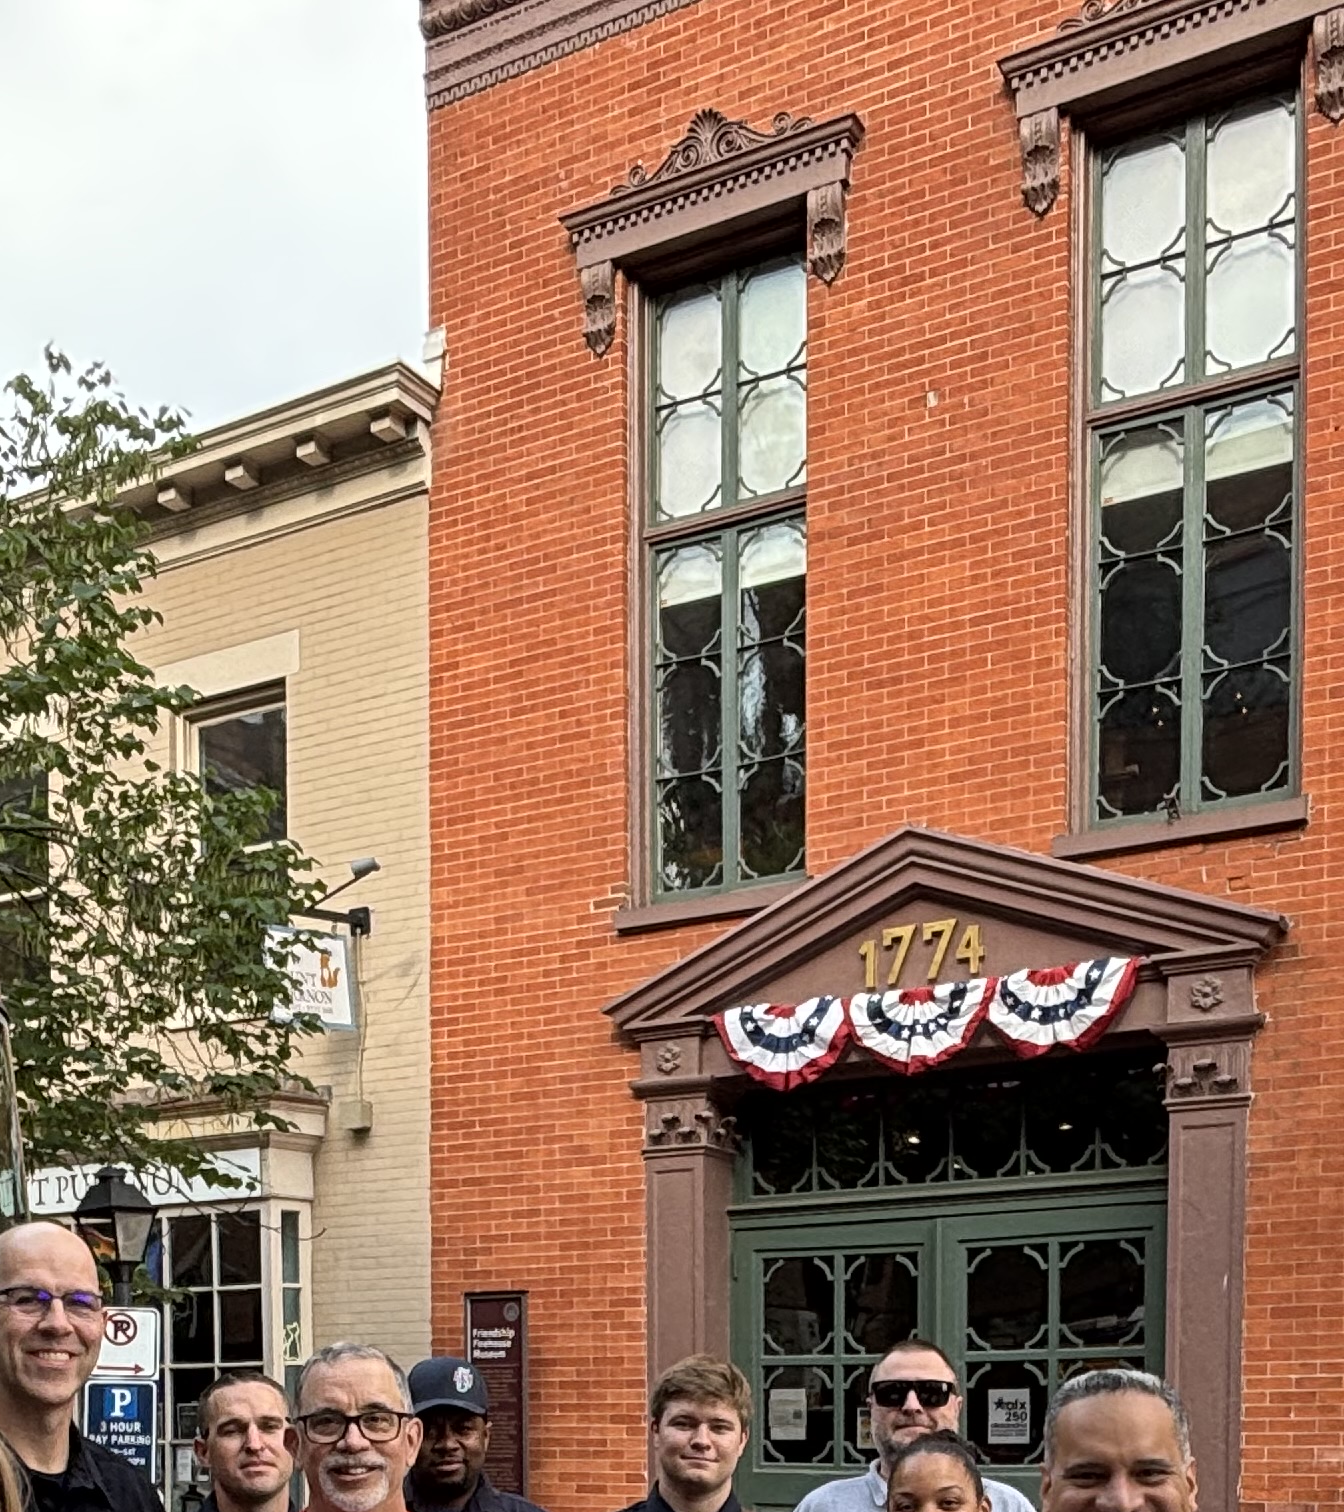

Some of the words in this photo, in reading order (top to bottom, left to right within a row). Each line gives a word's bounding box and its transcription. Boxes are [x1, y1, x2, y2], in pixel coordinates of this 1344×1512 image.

[858, 917, 986, 989] 1774
[1004, 1411, 1028, 1422] 250
[110, 1421, 142, 1433] HOUR
[111, 1434, 152, 1446] PARKING
